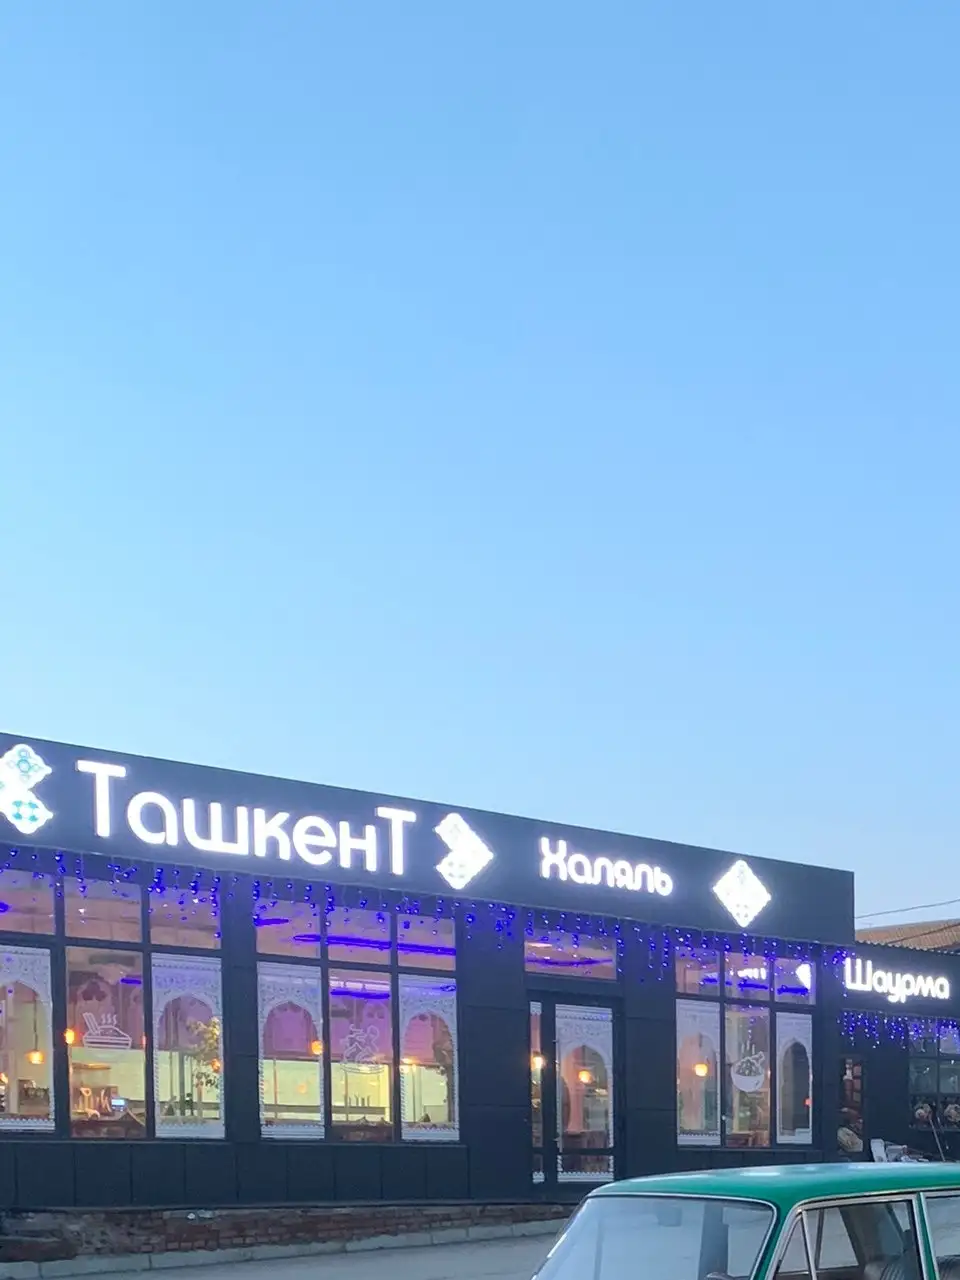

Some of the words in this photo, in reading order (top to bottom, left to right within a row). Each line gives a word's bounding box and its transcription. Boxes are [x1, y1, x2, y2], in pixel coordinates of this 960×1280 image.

[75, 759, 417, 875] Ташкент
[540, 836, 674, 897] Халяль
[844, 957, 950, 1003] Шаурма
